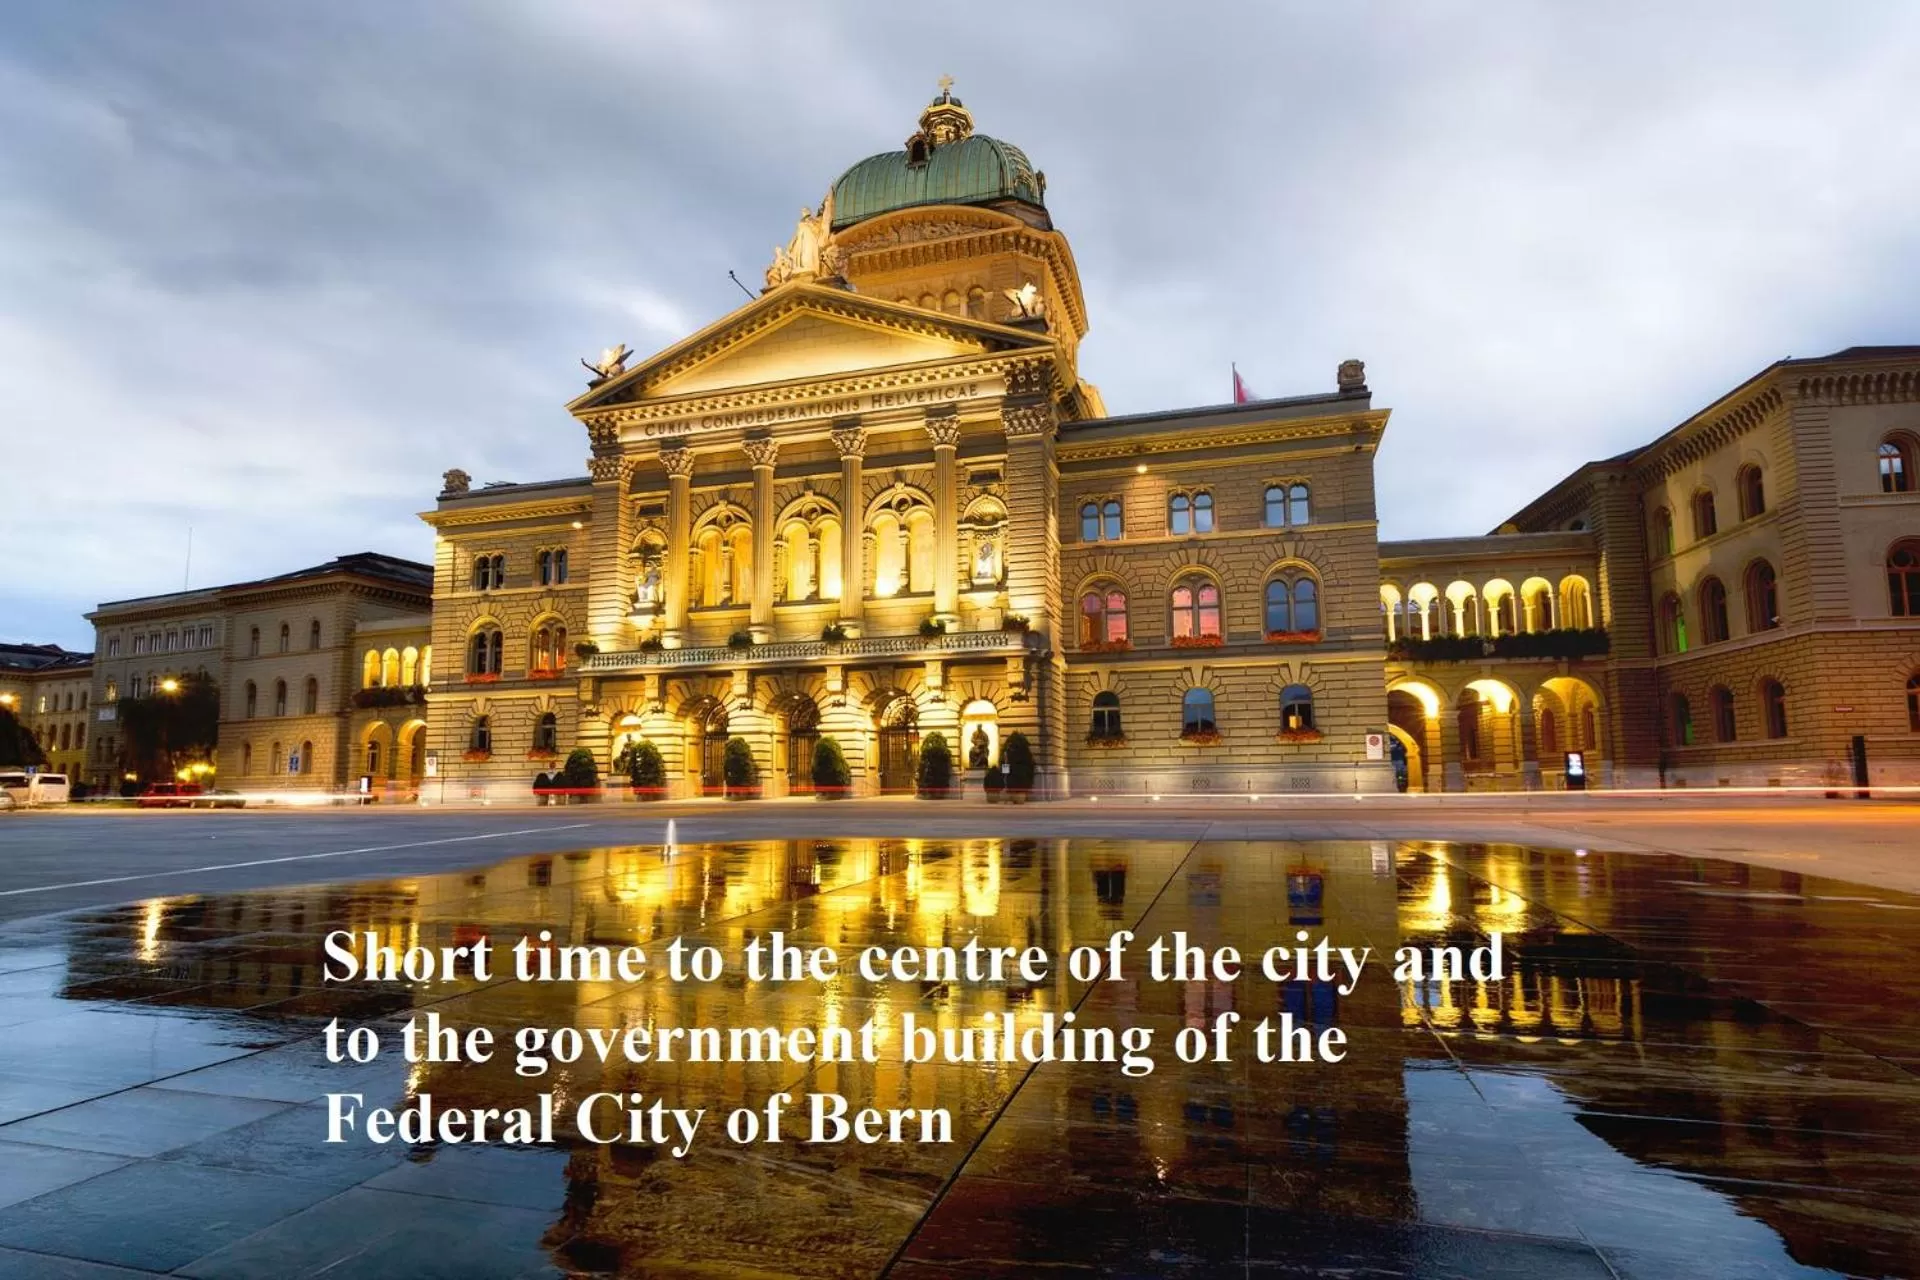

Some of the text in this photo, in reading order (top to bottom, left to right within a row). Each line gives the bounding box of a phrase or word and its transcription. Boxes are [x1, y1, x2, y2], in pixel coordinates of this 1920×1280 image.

[644, 383, 979, 437] CURIA CONFOEDERATIONIS HELVETICAE
